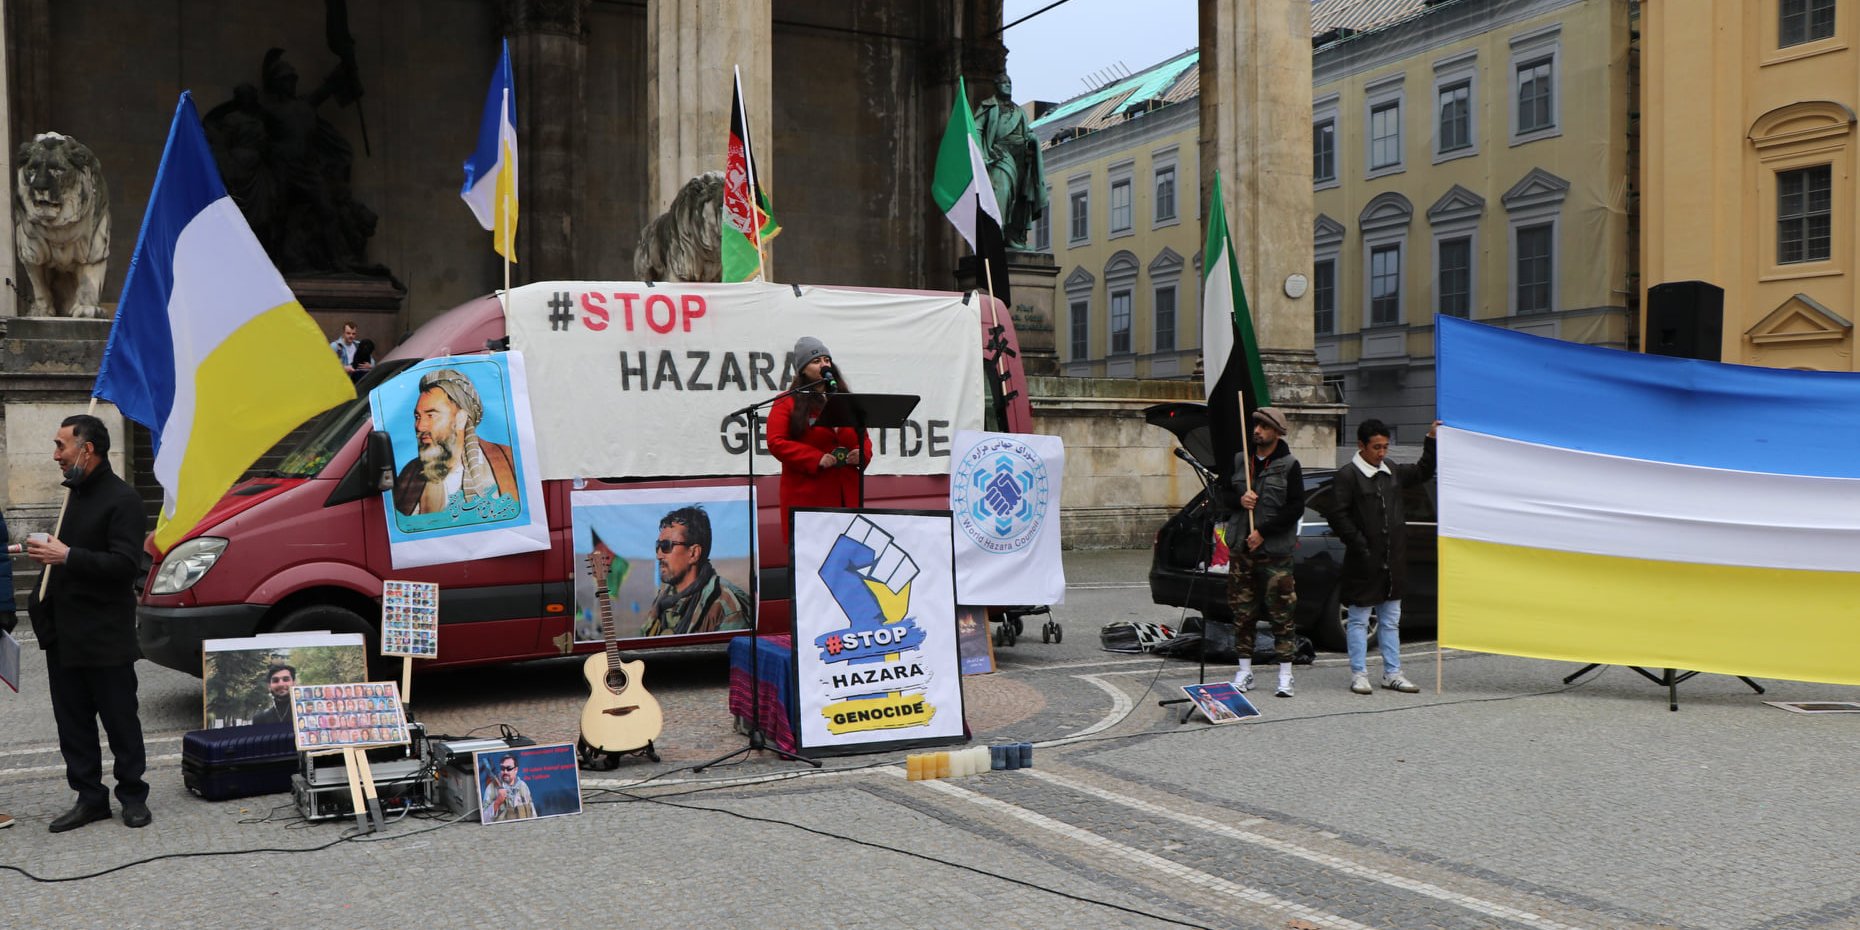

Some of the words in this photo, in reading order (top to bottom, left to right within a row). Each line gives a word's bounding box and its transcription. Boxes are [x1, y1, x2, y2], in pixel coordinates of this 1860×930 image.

[547, 291, 706, 334] #STOP
[720, 415, 950, 457] GEIDE
[963, 518, 985, 543] World
[984, 538, 1013, 551] Hazara
[1014, 520, 1039, 547] Council
[825, 626, 907, 655] #STOP
[832, 663, 924, 688] HAZARA
[833, 702, 924, 725] GENOCIDE
